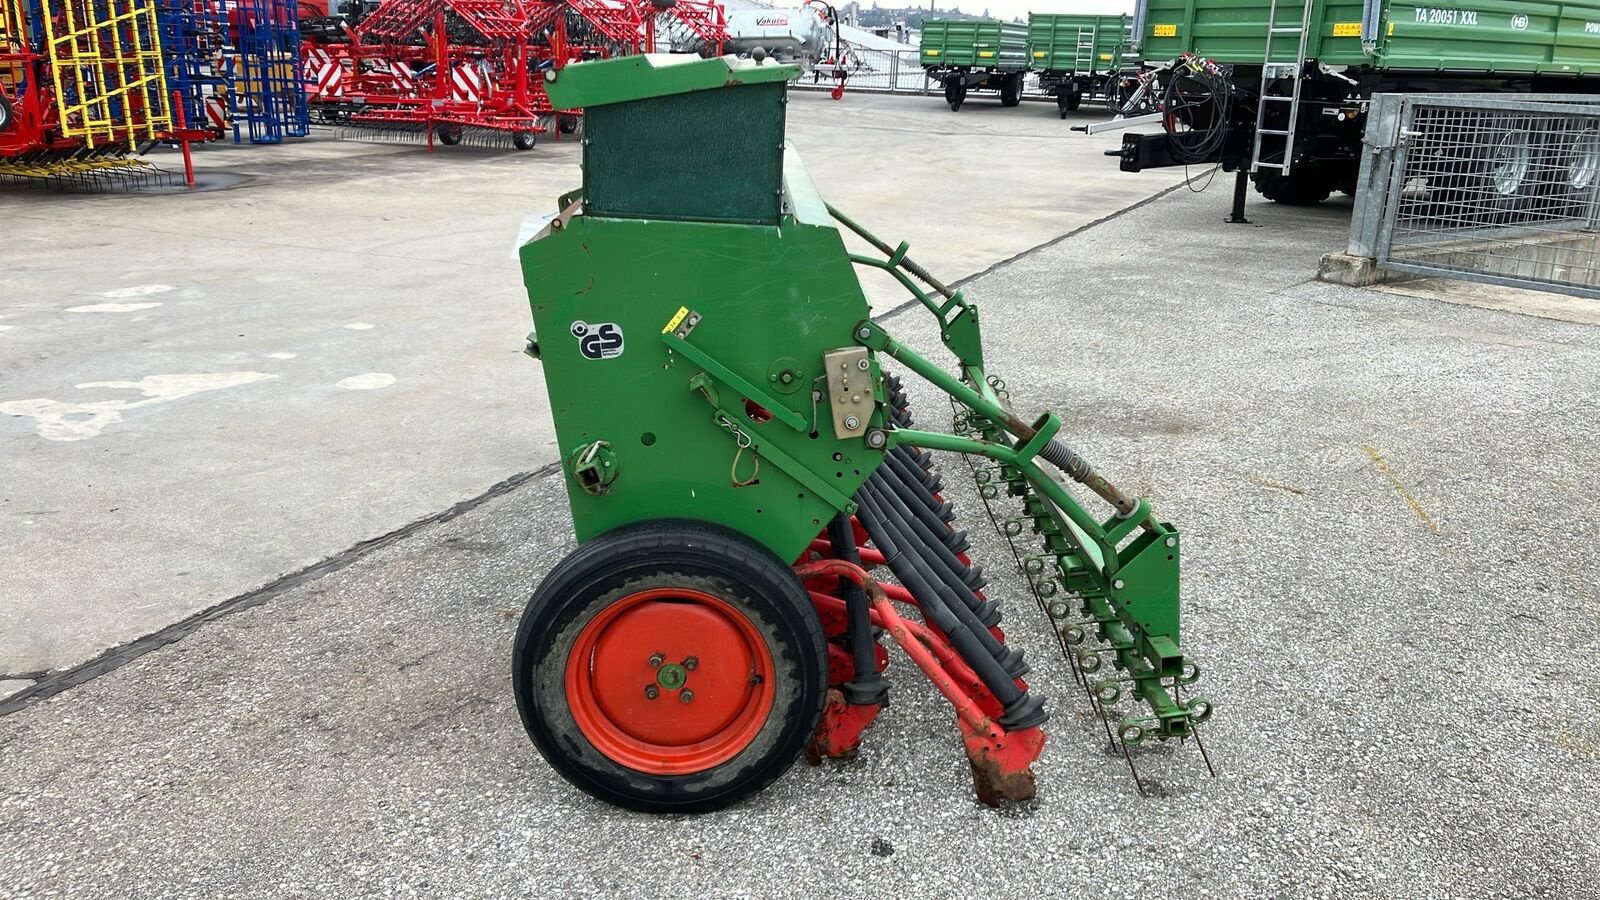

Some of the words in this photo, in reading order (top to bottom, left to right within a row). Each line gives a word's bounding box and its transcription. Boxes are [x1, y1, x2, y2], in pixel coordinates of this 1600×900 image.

[1416, 8, 1427, 23] TA
[1429, 9, 1457, 24] 20051
[1460, 11, 1478, 25] XXL
[580, 325, 622, 358] GS
